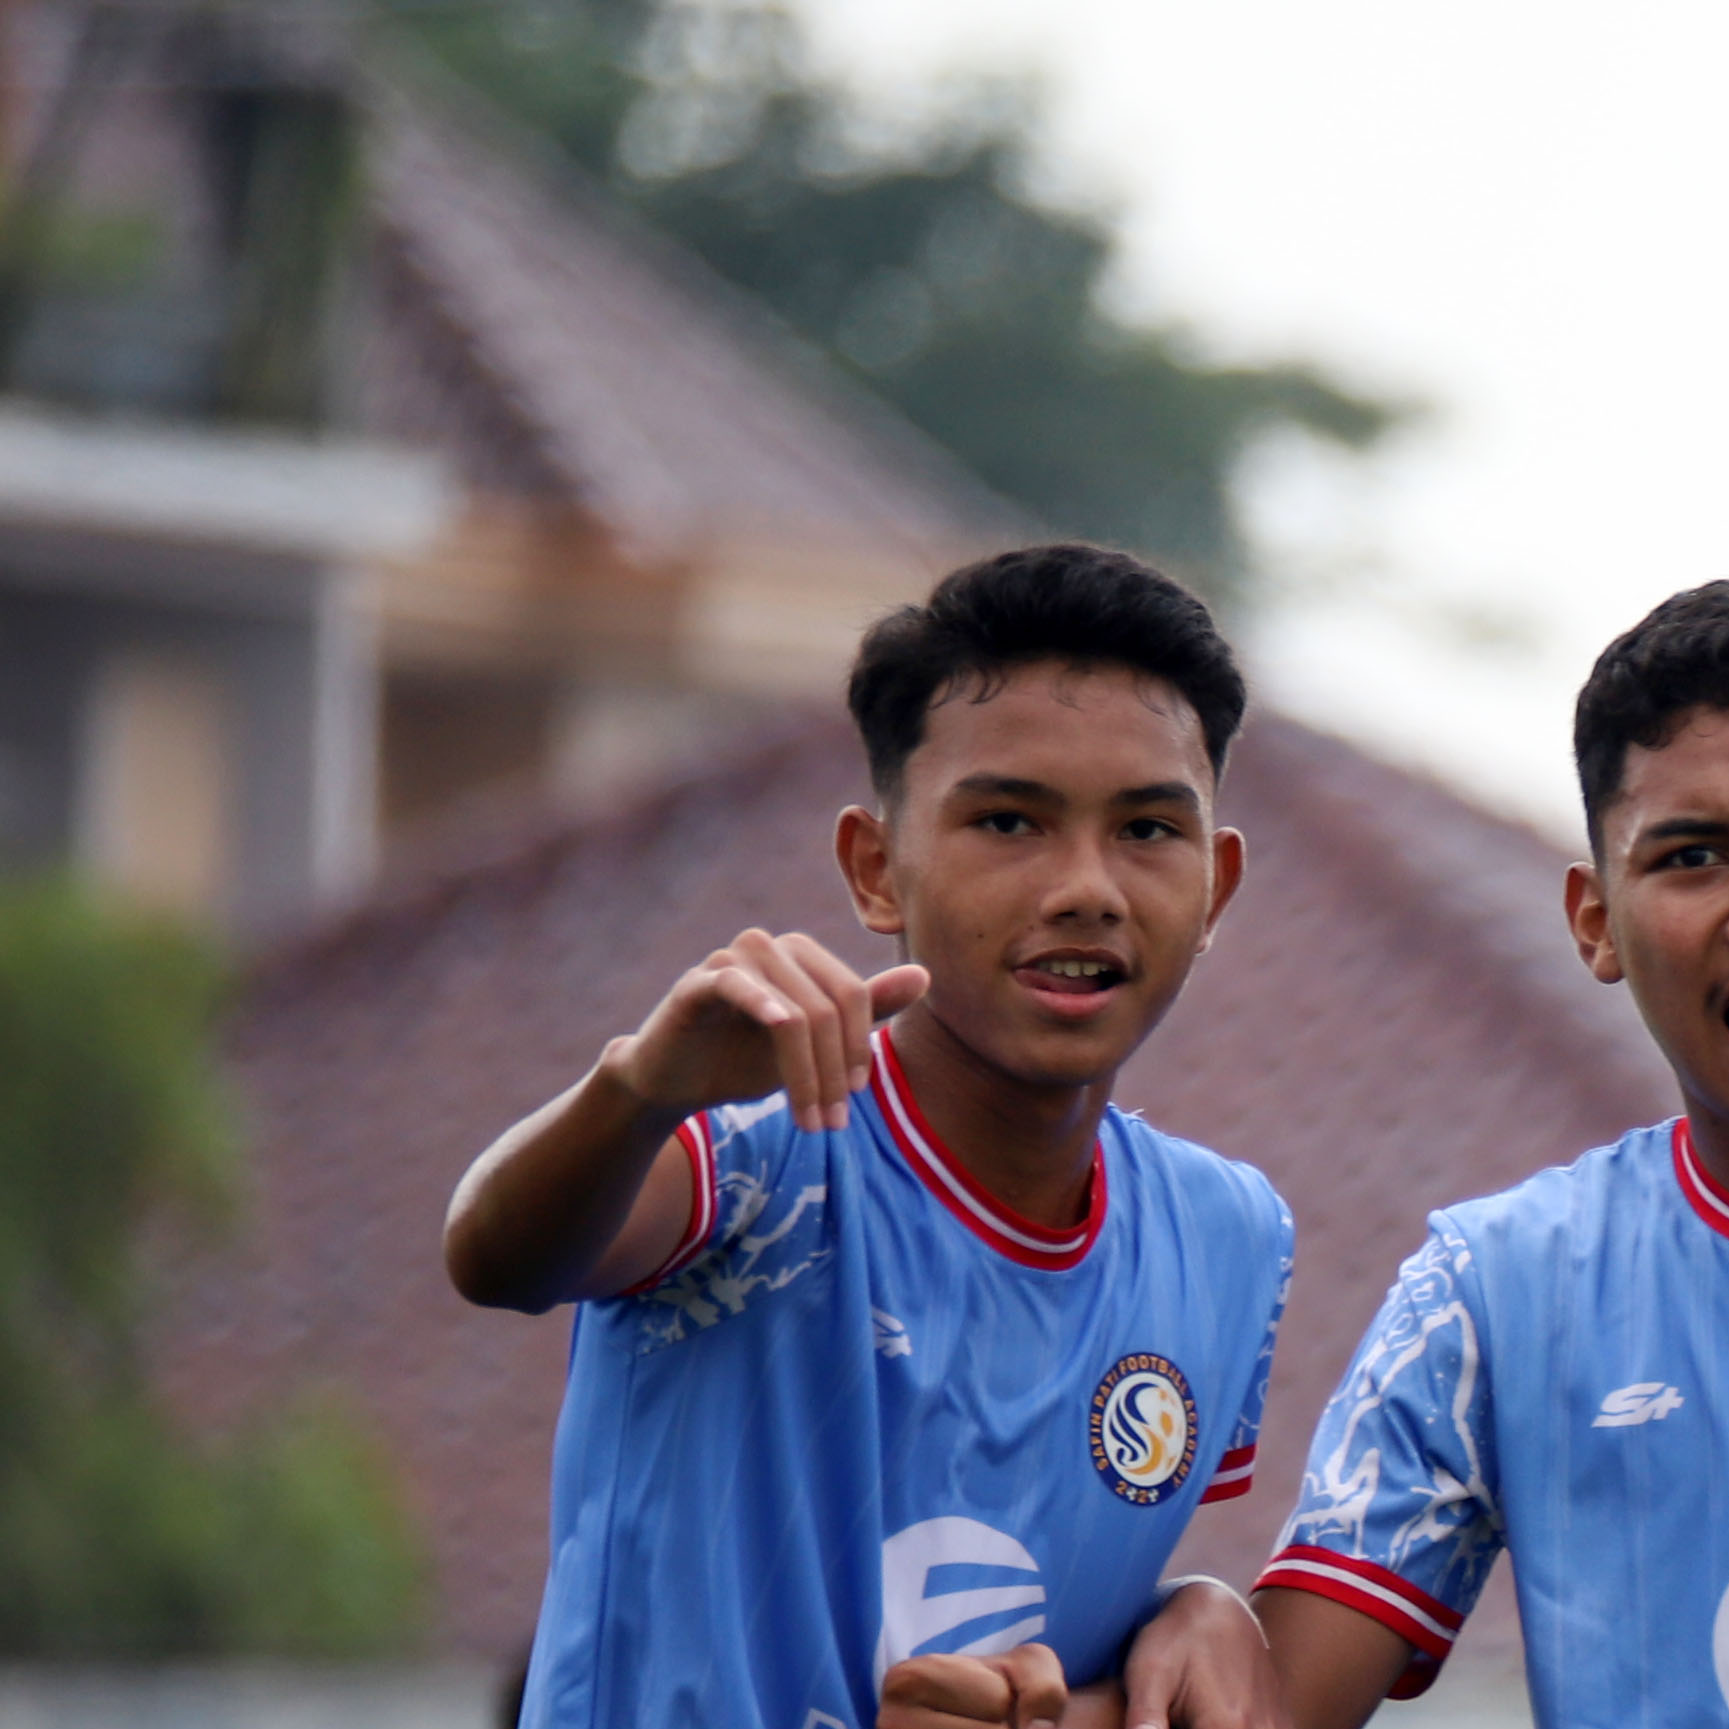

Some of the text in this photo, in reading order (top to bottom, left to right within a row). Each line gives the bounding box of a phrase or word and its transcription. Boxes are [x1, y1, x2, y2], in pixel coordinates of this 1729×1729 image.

[1089, 1353, 1198, 1488] SAFIN PATI FOOTBALL ACADEMY
